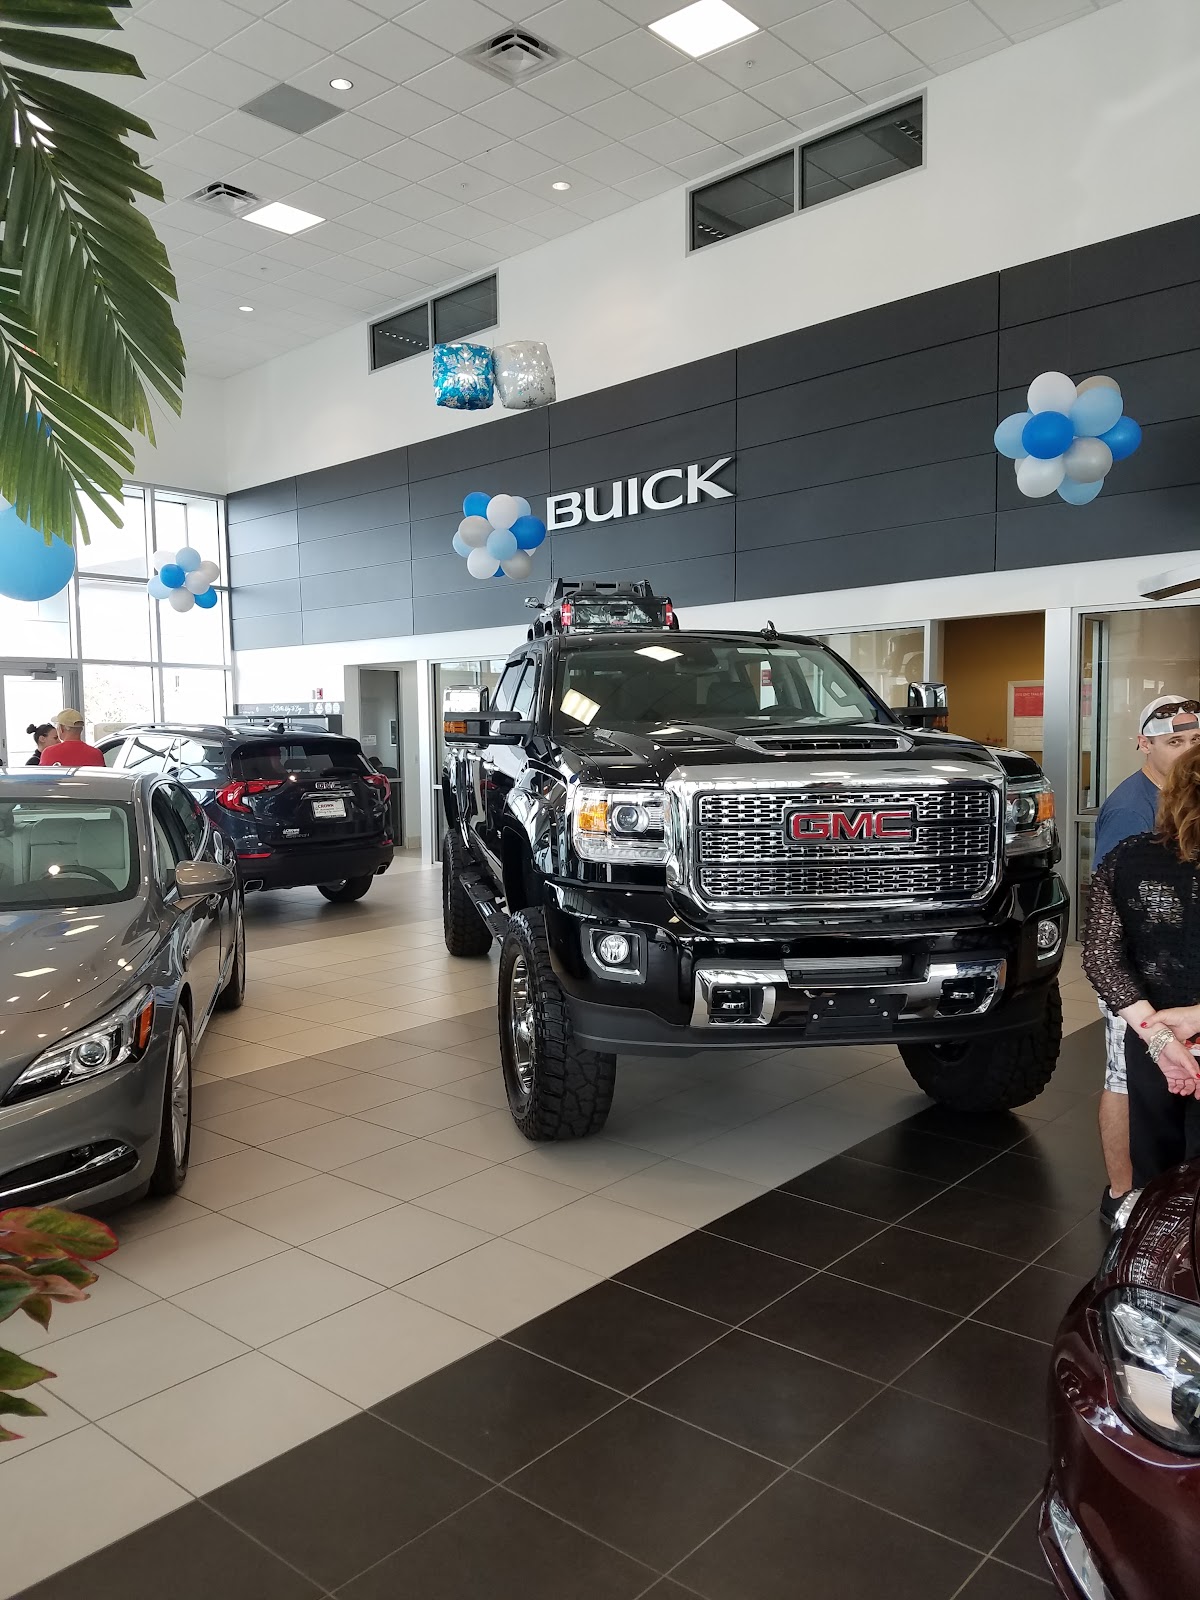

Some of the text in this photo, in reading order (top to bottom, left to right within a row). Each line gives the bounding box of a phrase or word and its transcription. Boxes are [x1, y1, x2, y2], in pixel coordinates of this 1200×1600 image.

[546, 456, 735, 531] BUICK
[315, 781, 341, 790] GMC
[791, 810, 912, 840] GMC
